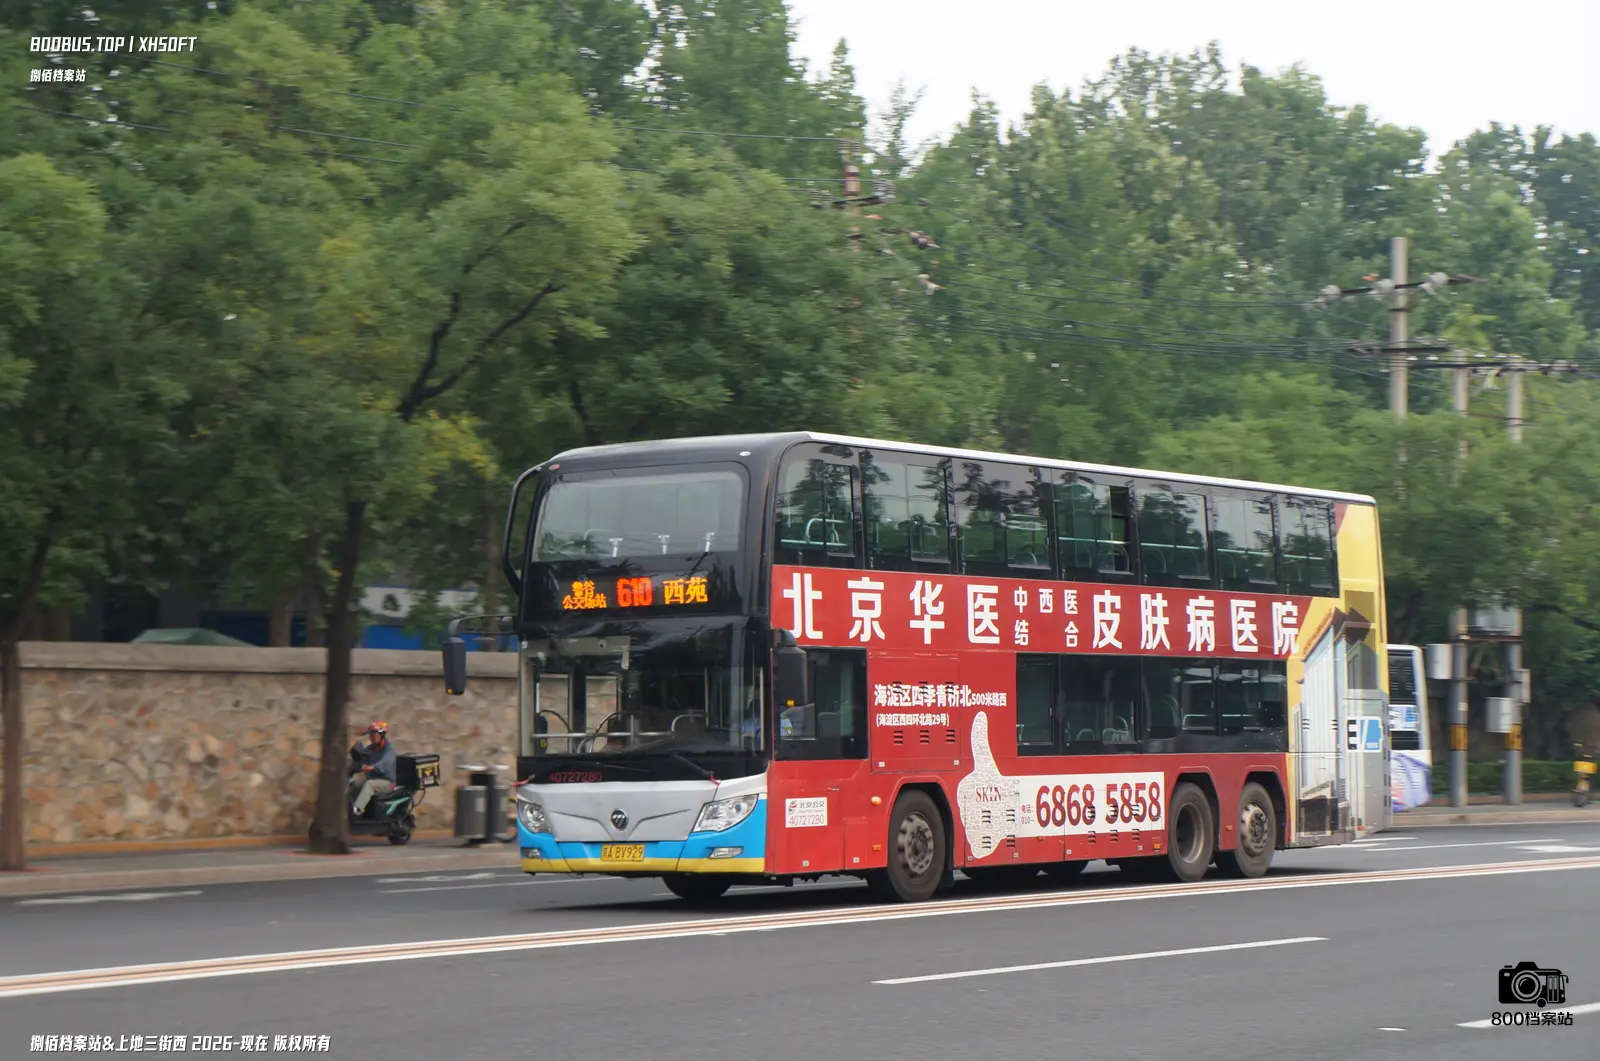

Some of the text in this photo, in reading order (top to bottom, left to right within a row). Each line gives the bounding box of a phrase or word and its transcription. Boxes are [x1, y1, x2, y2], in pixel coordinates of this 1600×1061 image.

[562, 593, 607, 610] 公交场站
[615, 576, 653, 608] 610
[663, 577, 708, 605] 西苑
[1092, 589, 1300, 655] 皮肤病医院
[548, 771, 603, 783] 40727280
[976, 786, 1002, 803] SKIN
[1035, 783, 1096, 828] 6868
[789, 814, 825, 826] 40727280
